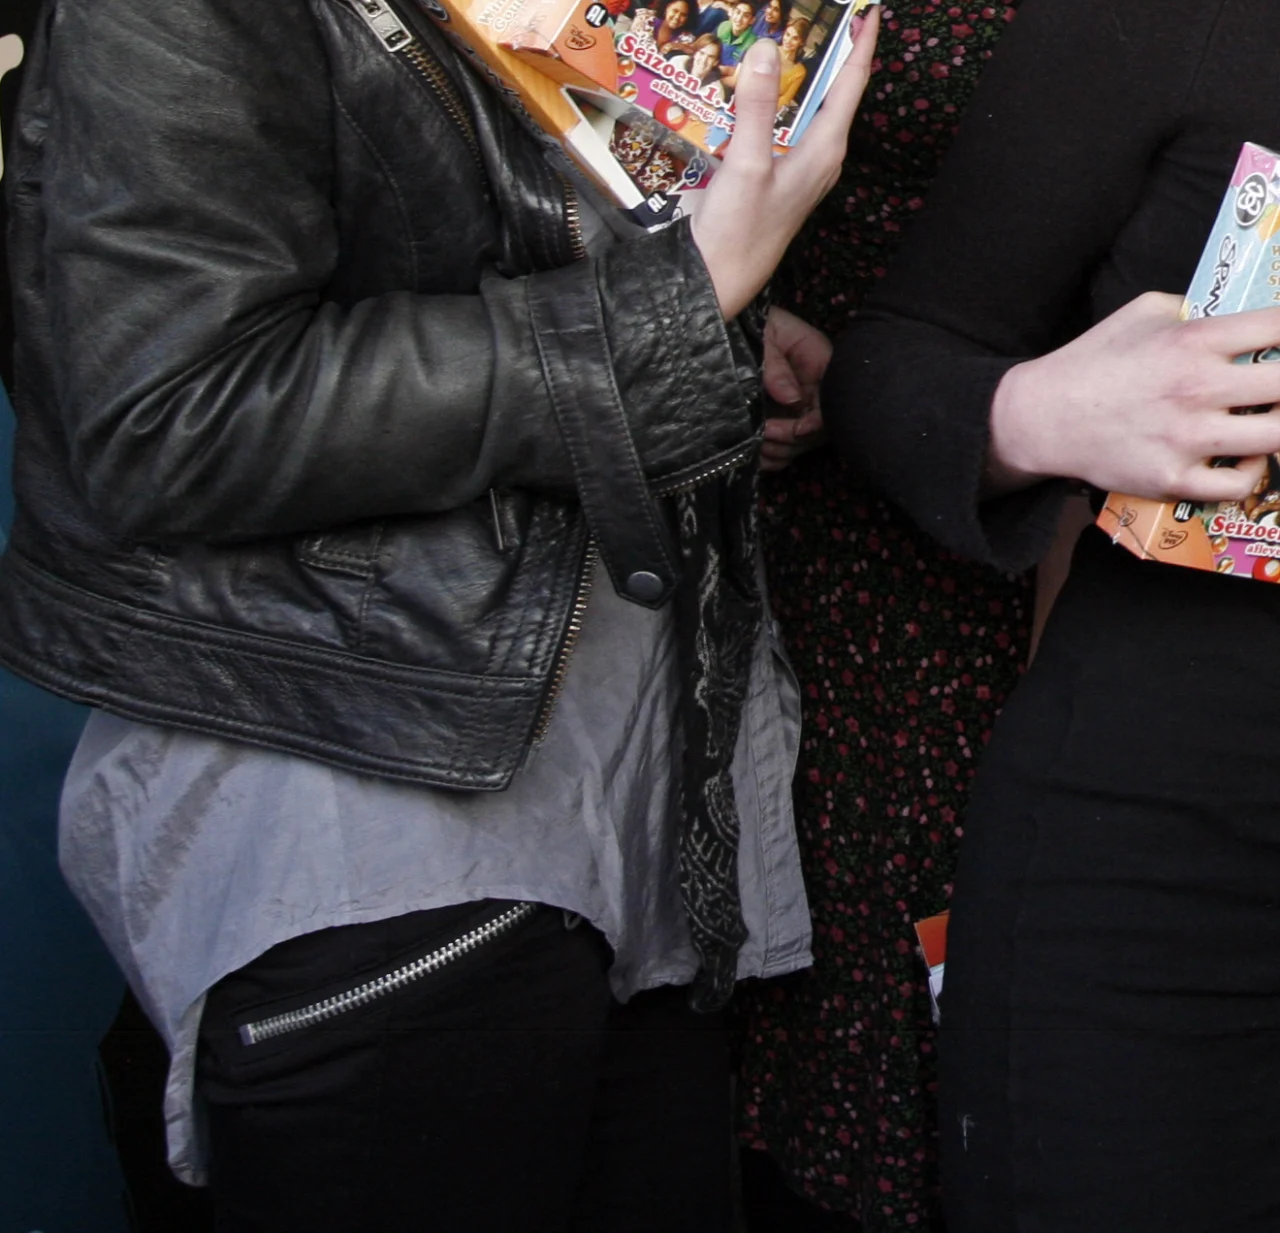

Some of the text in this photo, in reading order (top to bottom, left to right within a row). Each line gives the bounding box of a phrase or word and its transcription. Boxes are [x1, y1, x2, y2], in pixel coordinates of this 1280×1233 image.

[587, 7, 607, 25] AL
[620, 36, 701, 93] Seizoen
[651, 80, 716, 122] aflevering:
[647, 193, 667, 213] AL
[1174, 503, 1190, 519] AL
